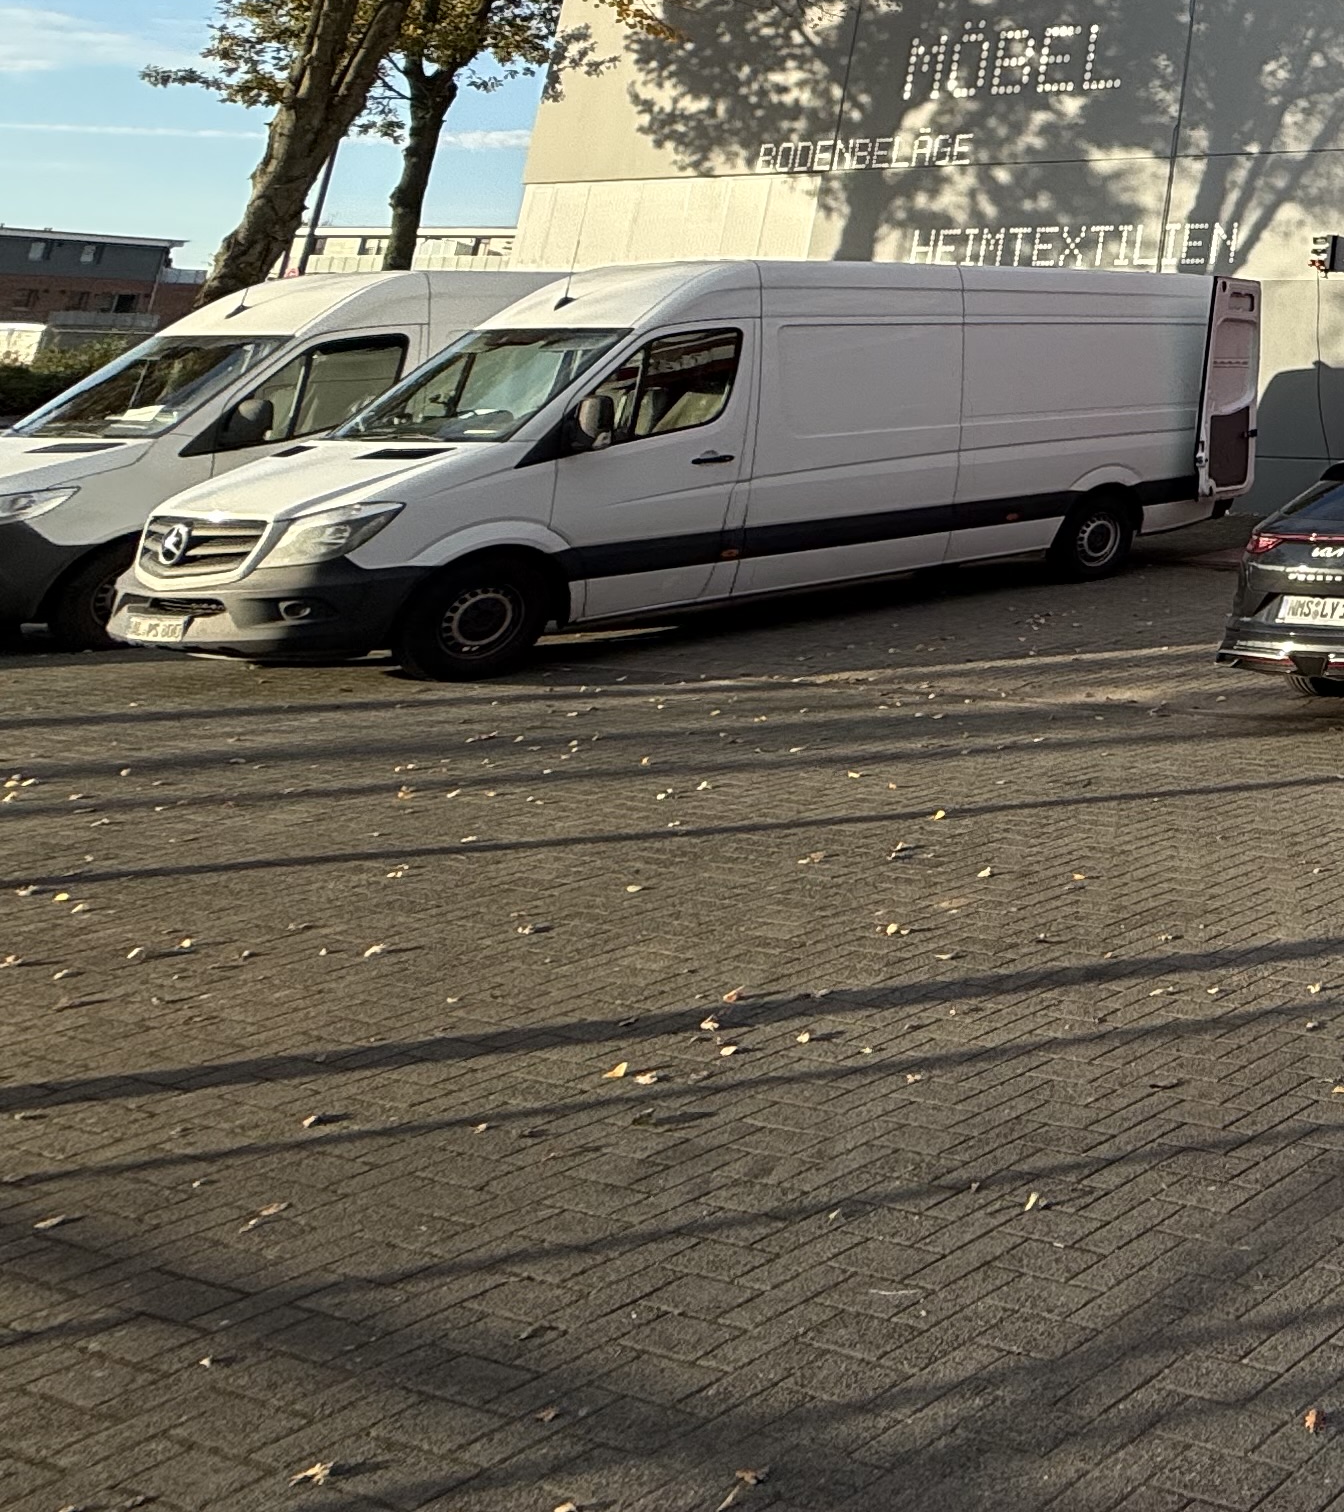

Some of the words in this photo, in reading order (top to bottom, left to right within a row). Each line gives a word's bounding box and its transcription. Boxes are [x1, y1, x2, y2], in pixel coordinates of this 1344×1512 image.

[902, 19, 1121, 101] MÖBEL
[756, 127, 974, 174] BODENBELÄGE
[909, 221, 1240, 268] HEIMTEXTILIEN
[1287, 599, 1313, 617] NMS
[1320, 600, 1340, 619] LY
